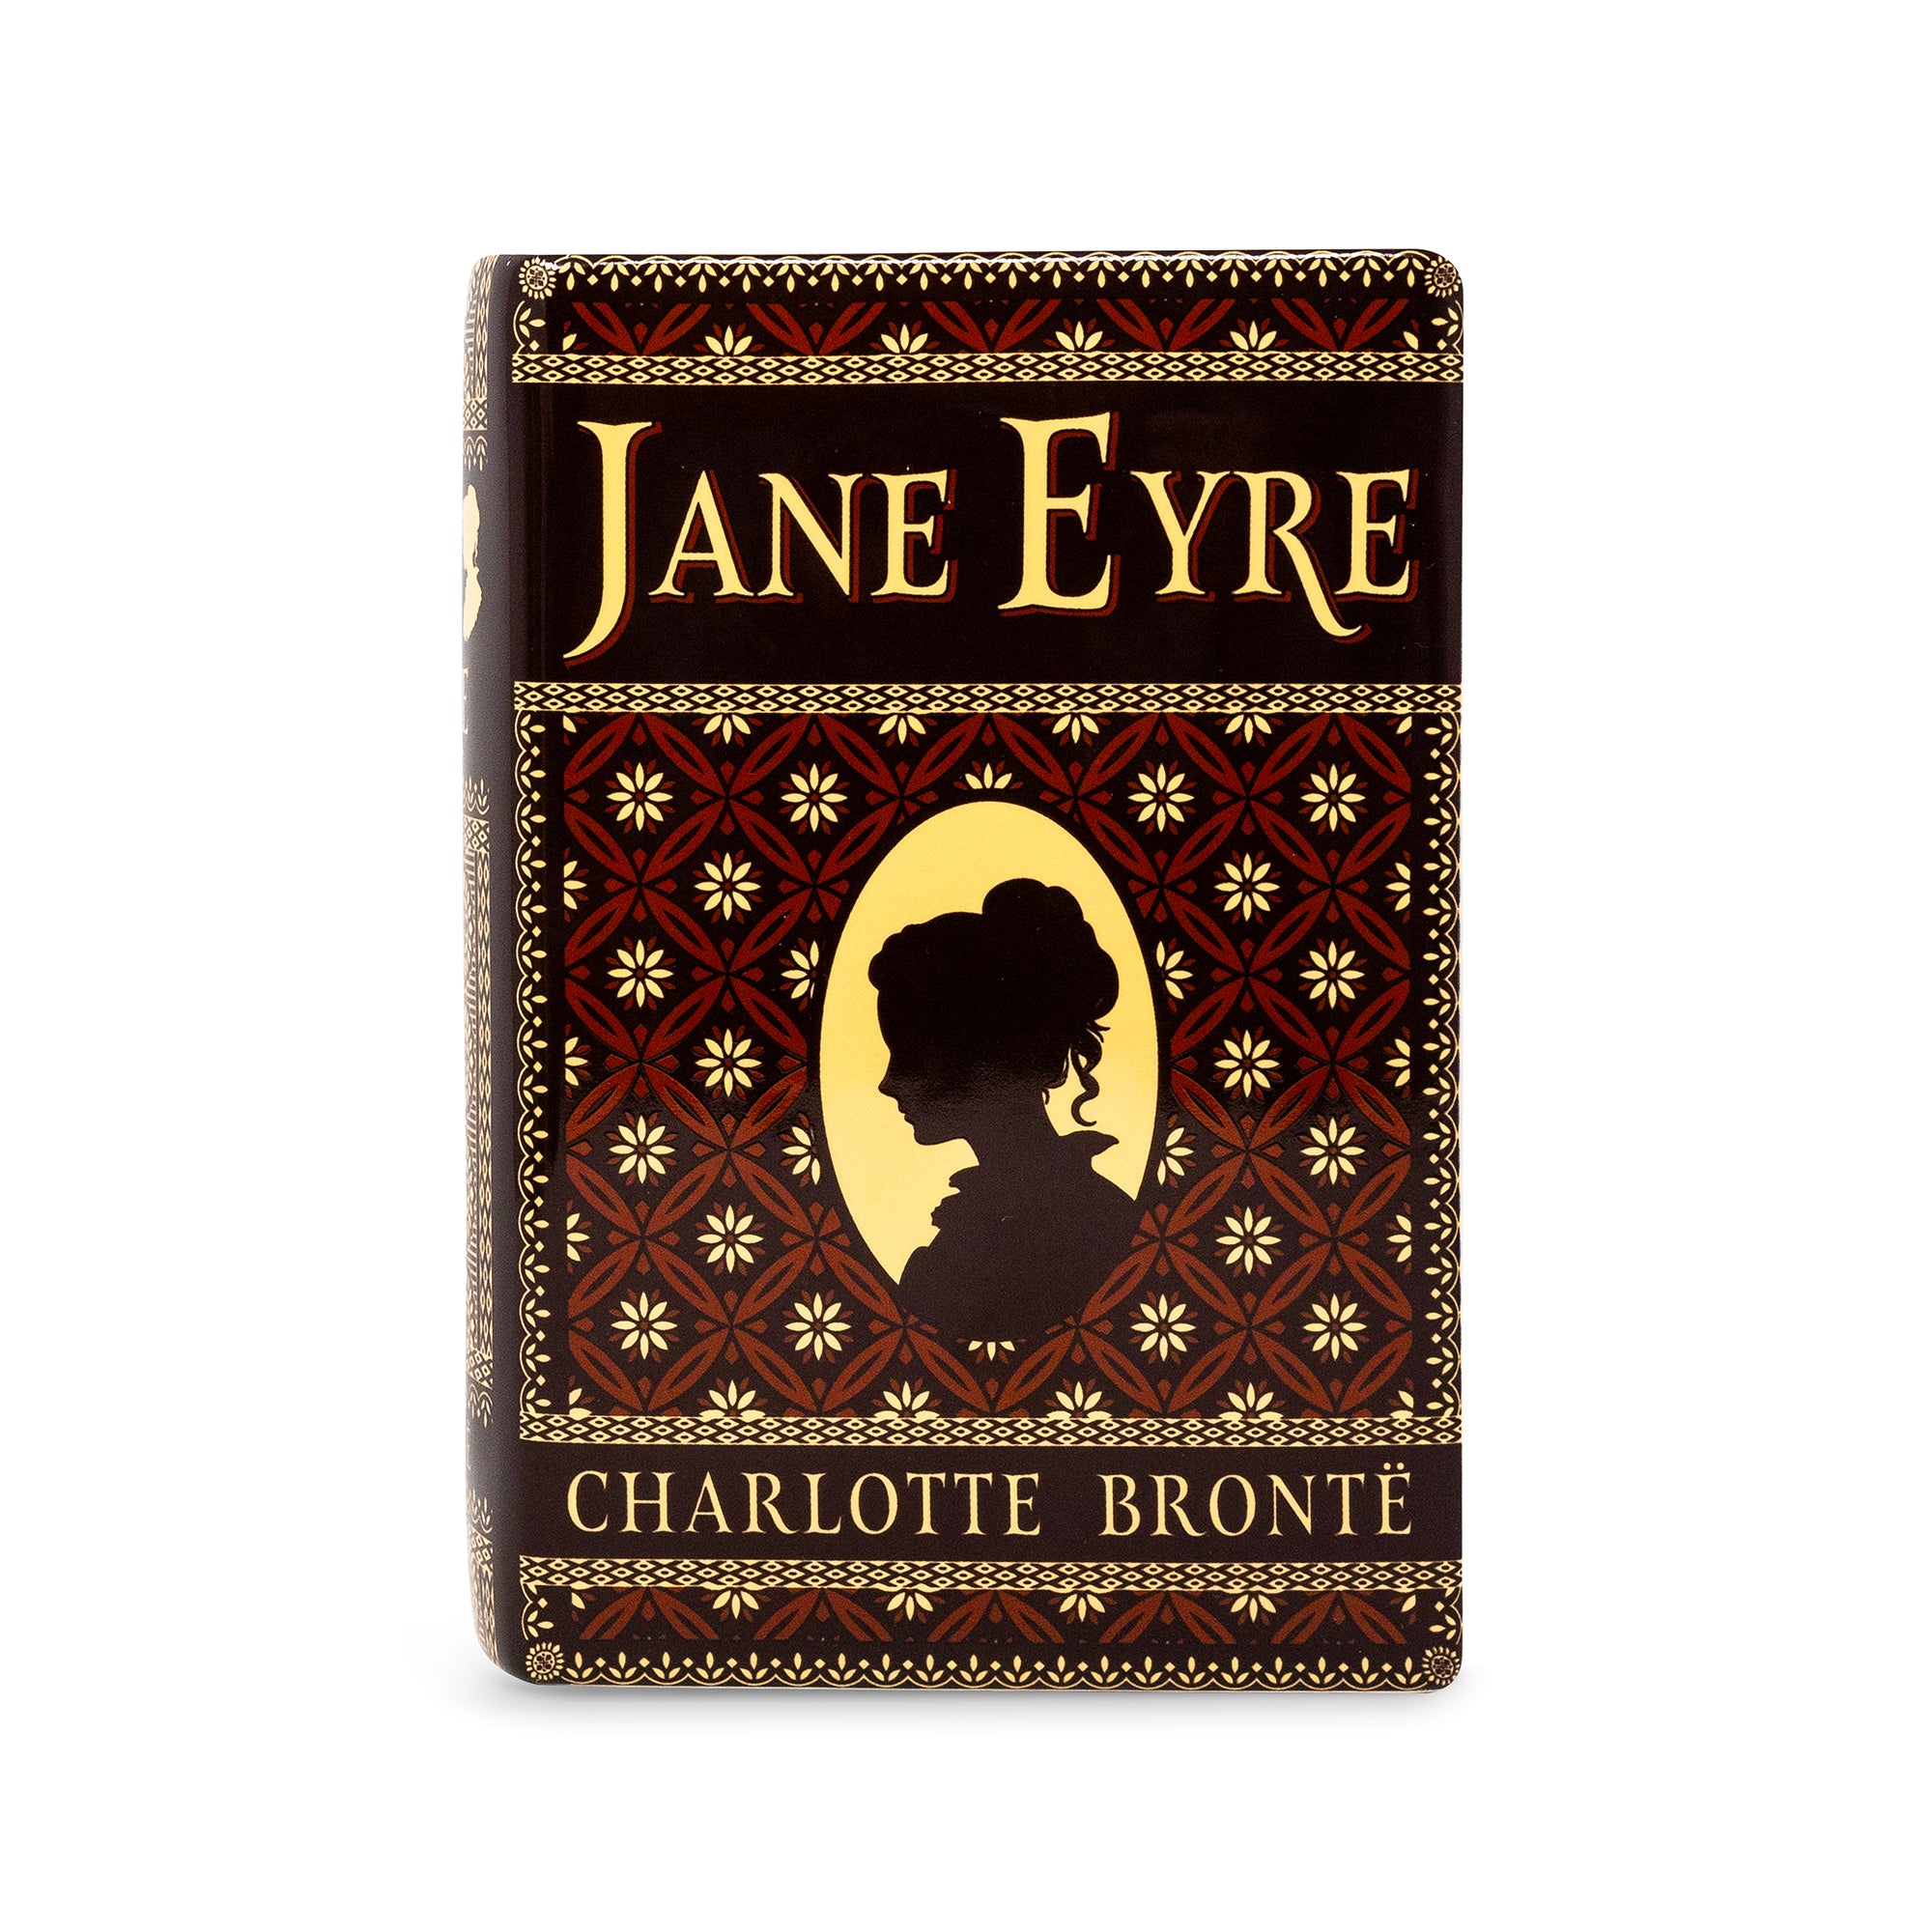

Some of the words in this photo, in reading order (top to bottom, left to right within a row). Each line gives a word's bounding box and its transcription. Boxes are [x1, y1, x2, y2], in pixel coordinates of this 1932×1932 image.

[562, 418, 953, 661] JANE
[996, 411, 1415, 639] EYRE
[566, 1469, 1041, 1536] CHARLOTTE
[1096, 1462, 1412, 1538] BRONTË
